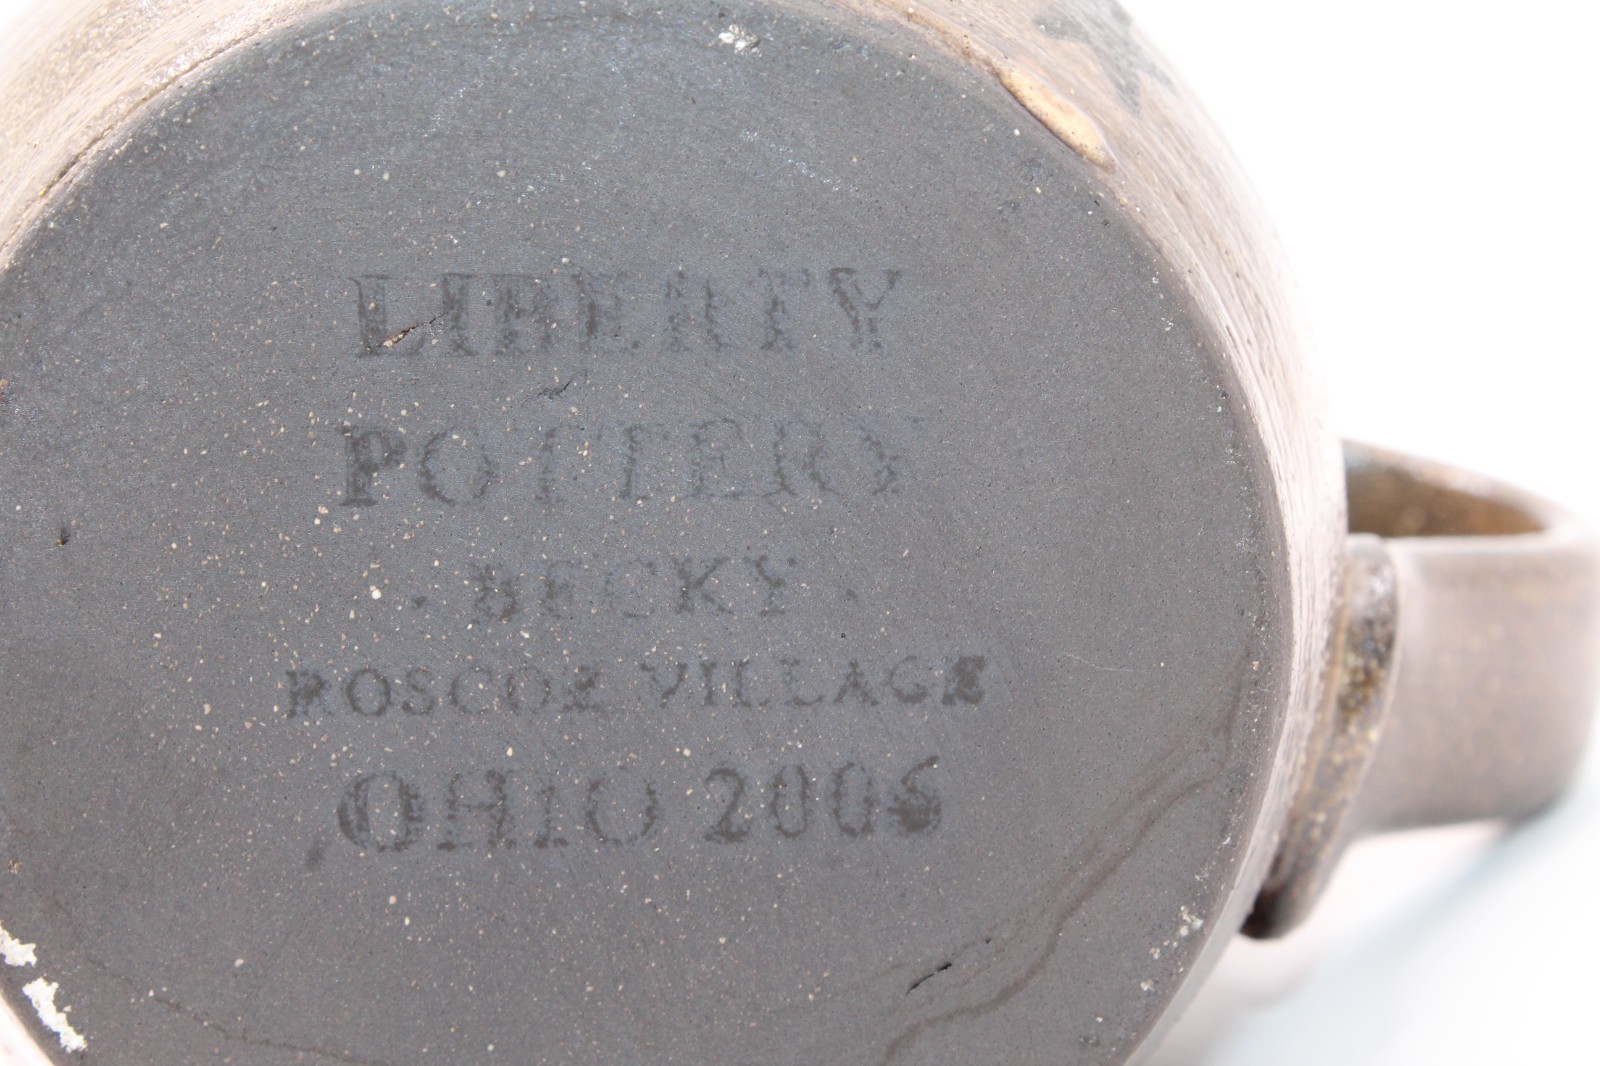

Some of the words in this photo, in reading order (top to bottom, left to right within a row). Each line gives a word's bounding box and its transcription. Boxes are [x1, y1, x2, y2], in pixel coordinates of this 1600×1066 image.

[349, 265, 902, 360] LIBERTY
[336, 414, 926, 508] POTTERY
[472, 553, 798, 622] BECKY
[285, 663, 600, 719] ROSCOE
[639, 653, 988, 707] VILLAGE
[336, 768, 663, 854] OHIO
[703, 753, 943, 845] 2006
